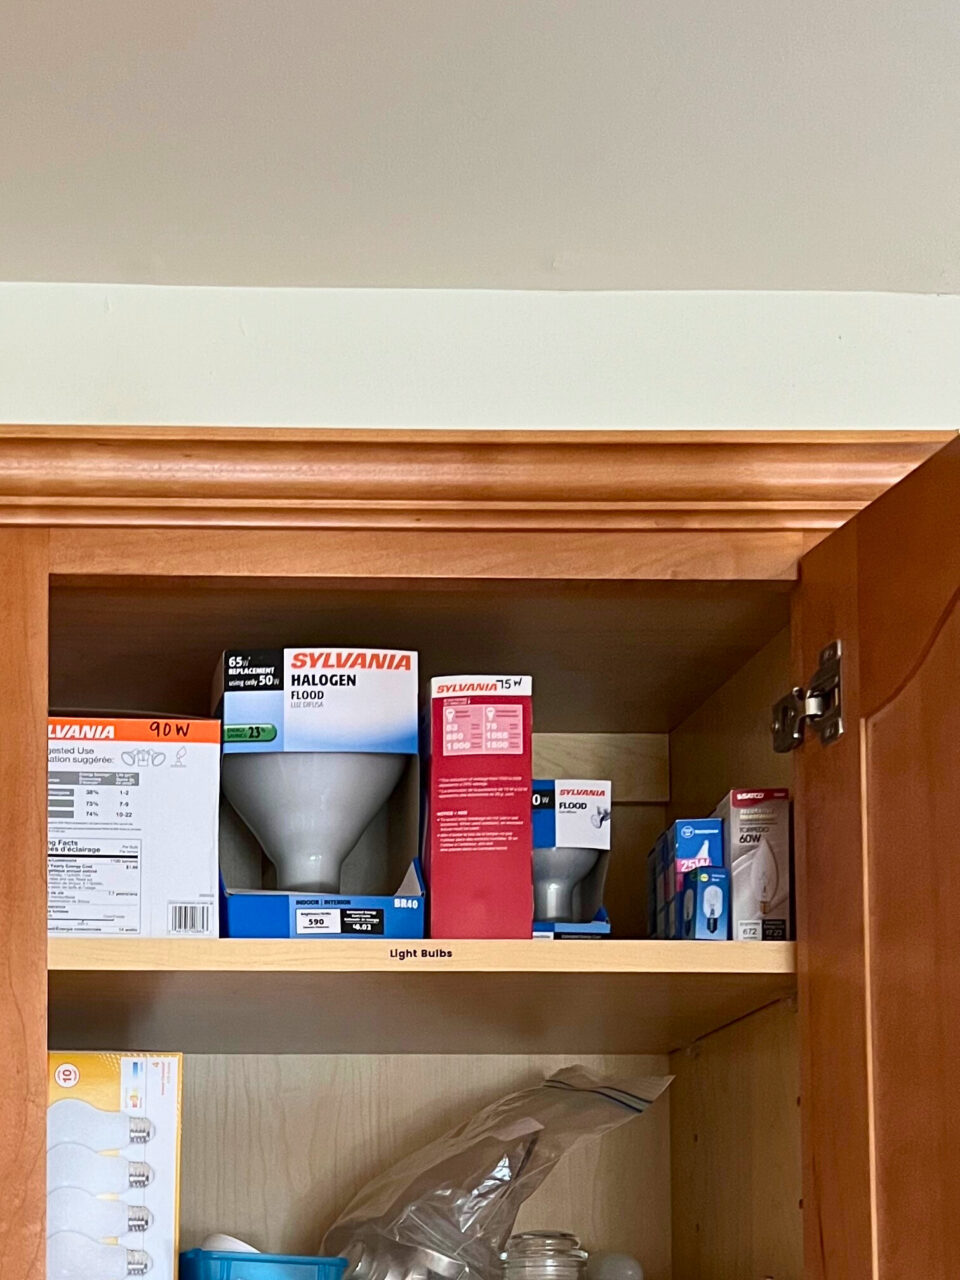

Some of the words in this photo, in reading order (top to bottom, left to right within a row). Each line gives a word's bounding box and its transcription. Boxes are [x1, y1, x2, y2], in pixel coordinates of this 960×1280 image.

[290, 653, 411, 670] SYLVANIA
[228, 667, 275, 675] REPLACEMENT
[228, 680, 244, 688] using
[245, 678, 258, 687] only
[291, 674, 356, 687] HALOGEN
[437, 683, 498, 694] SYLVANIA
[291, 690, 324, 700] FLOOD
[48, 724, 115, 739] LVANIA
[48, 746, 75, 757] gested
[78, 747, 95, 755] Use
[48, 755, 71, 764] ation
[559, 789, 606, 797] SYLVANIA
[559, 802, 587, 810] FLOOD
[739, 834, 761, 843] 60W
[681, 859, 710, 873] 25W
[393, 898, 419, 909] BR40
[308, 918, 325, 926] 590
[743, 927, 758, 935] 672
[390, 949, 418, 960] Light
[421, 948, 452, 958] Bulbs
[62, 1069, 72, 1083] 10
